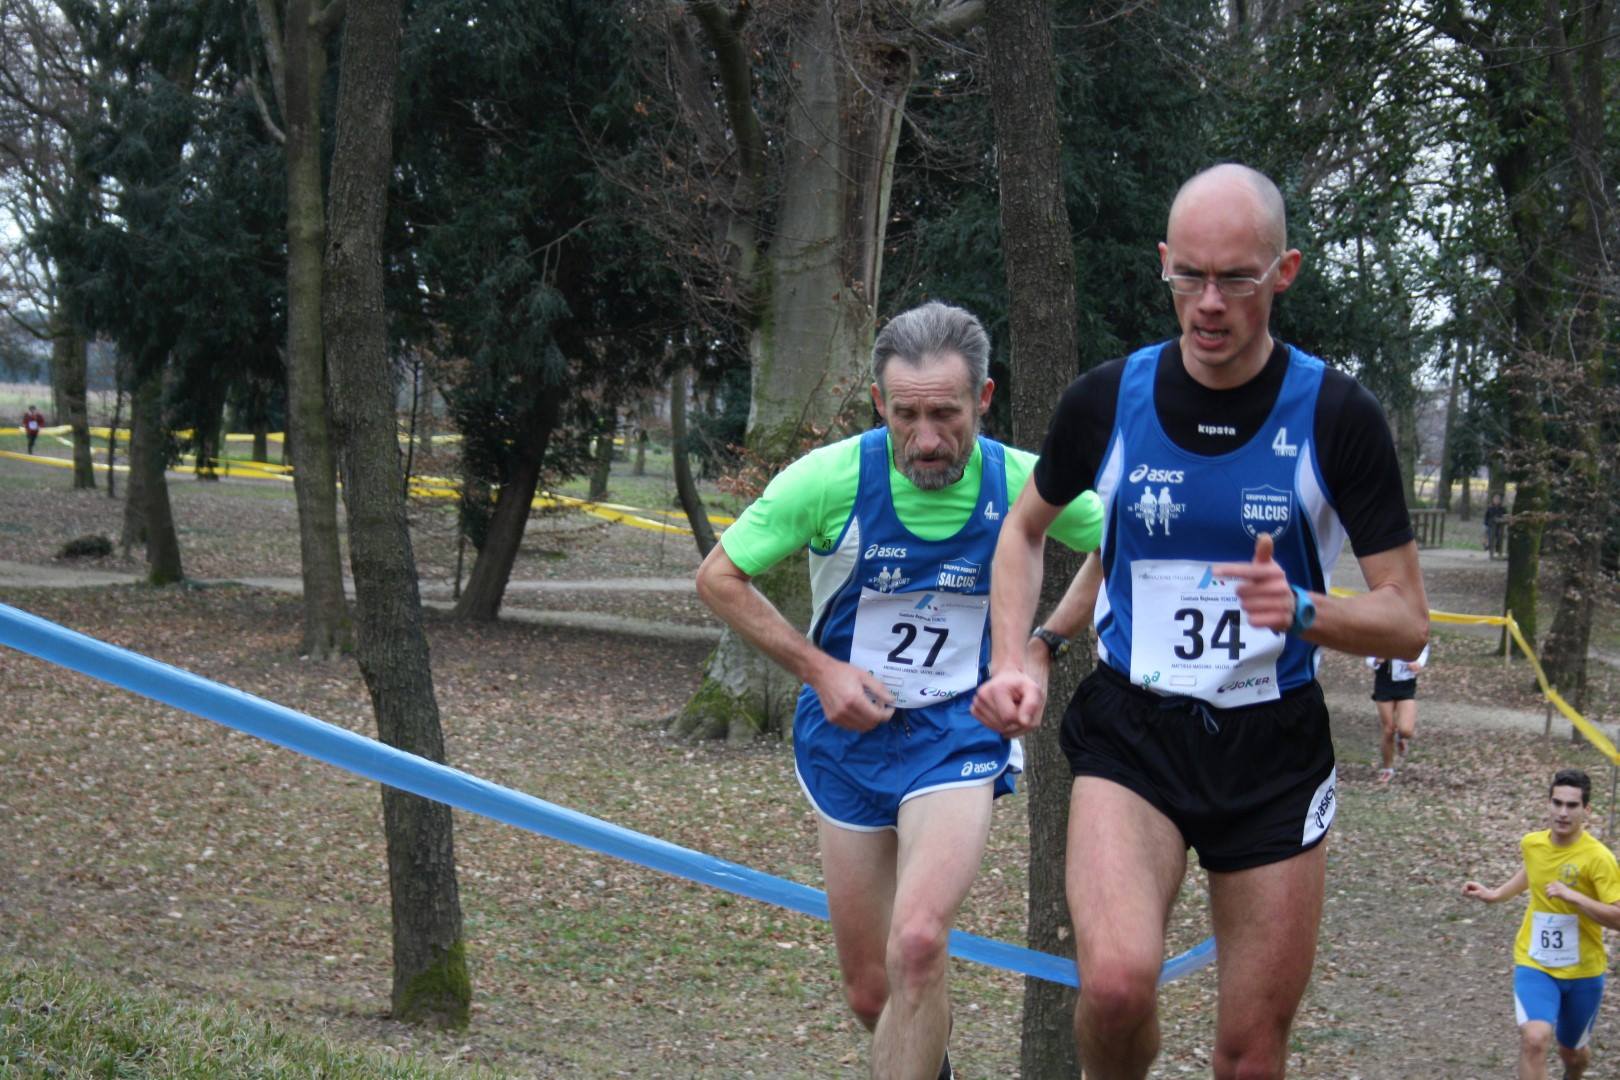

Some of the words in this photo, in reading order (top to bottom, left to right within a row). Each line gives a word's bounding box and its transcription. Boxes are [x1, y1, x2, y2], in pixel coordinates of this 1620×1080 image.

[1198, 423, 1236, 436] kipsta
[1147, 468, 1185, 484] asics
[1243, 503, 1289, 521] SALCUS
[877, 547, 907, 558] asics
[938, 572, 976, 589] SALCUS
[1173, 608, 1246, 661] 34
[887, 622, 949, 668] 27
[932, 688, 958, 698] JOK
[973, 760, 998, 774] asics
[1318, 785, 1336, 817] asics
[1541, 930, 1563, 949] 63
